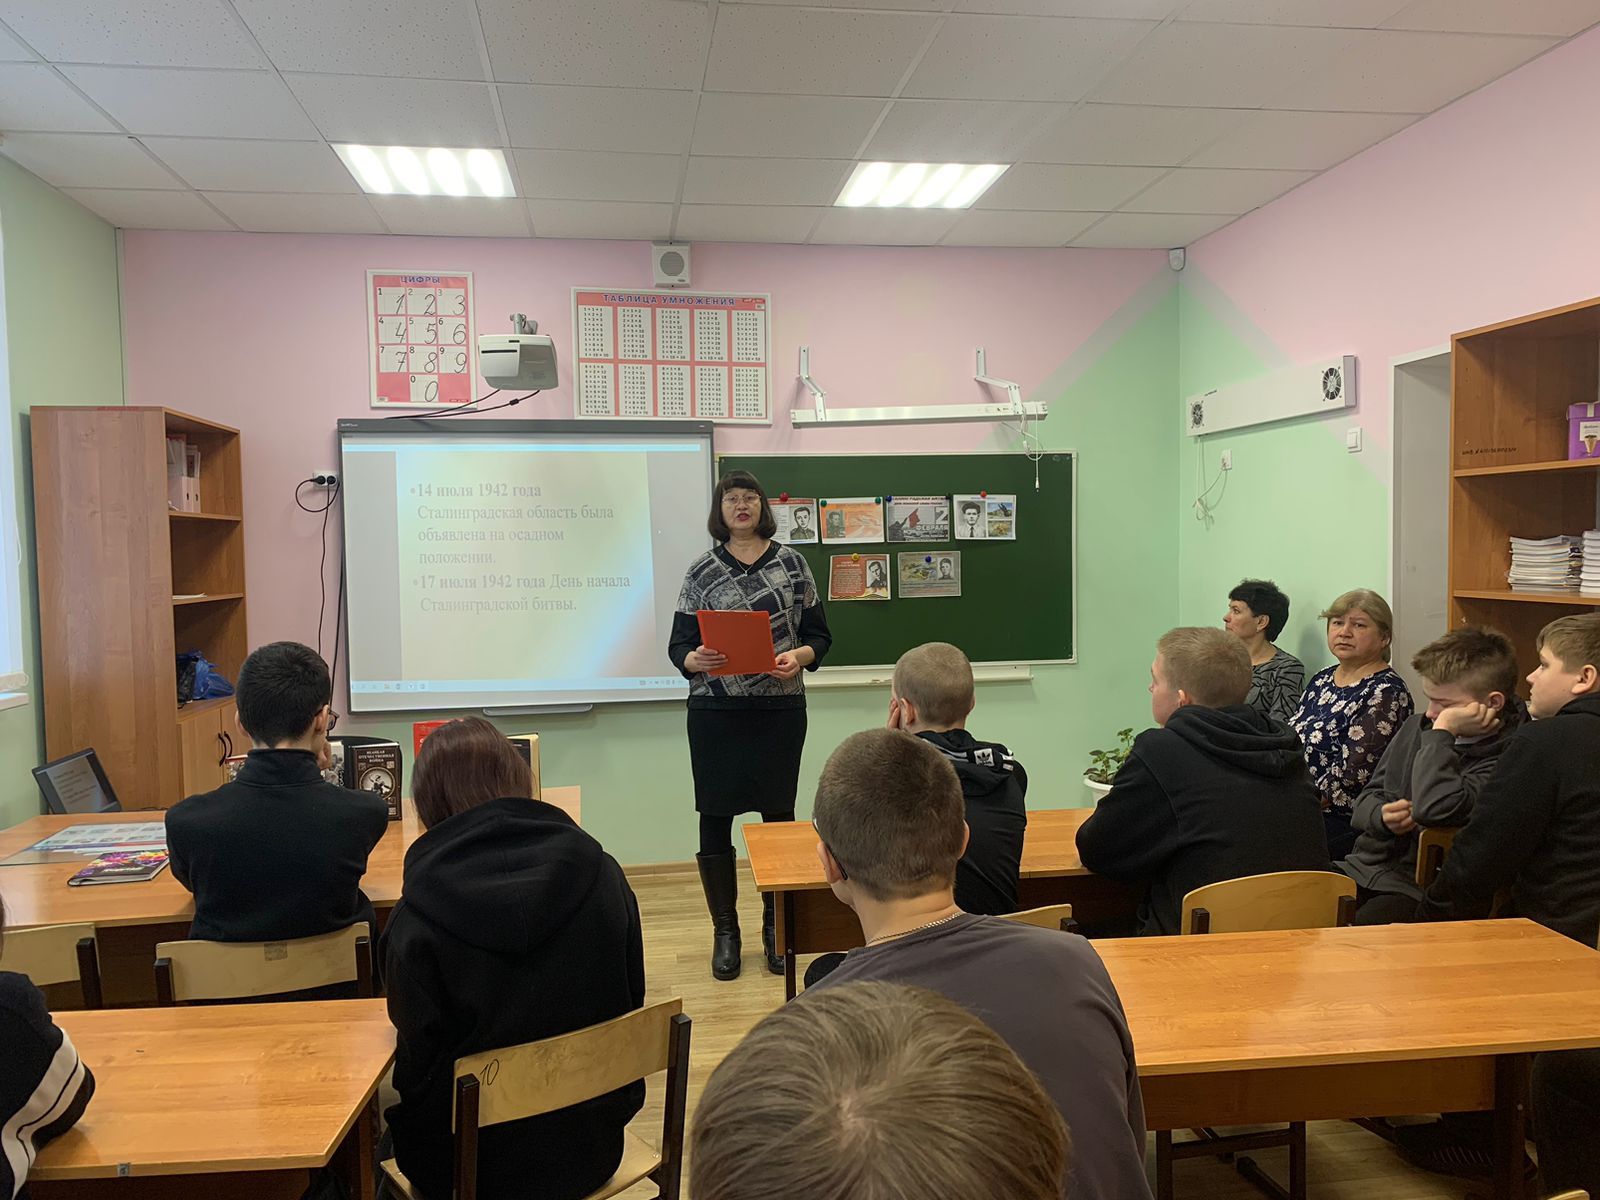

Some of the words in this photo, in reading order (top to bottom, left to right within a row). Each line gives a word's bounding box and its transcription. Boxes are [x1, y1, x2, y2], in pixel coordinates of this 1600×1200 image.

[396, 294, 405, 313] 1
[424, 294, 436, 315] 2
[453, 295, 465, 315] 3
[604, 294, 657, 303] ТАБЛИЦА
[662, 296, 735, 305] УМНОЖЕНИЯ
[395, 322, 406, 343] 4
[425, 324, 436, 344] 5
[453, 324, 466, 344] 6
[396, 352, 406, 371] 7
[424, 352, 437, 373] 8
[455, 352, 467, 373] 9
[425, 381, 438, 402] 0
[417, 484, 432, 497] 14
[437, 486, 473, 498] июля
[478, 484, 508, 497] 1942
[512, 486, 541, 498] года
[418, 505, 523, 522] Сталинградская
[527, 506, 577, 519] область
[580, 506, 614, 519] была
[418, 528, 485, 542] объявлена
[490, 530, 506, 541] на
[509, 531, 564, 543] осадном
[419, 552, 496, 566] положении.
[420, 576, 434, 589] 17
[440, 578, 477, 590] июля
[482, 575, 512, 589] 1942
[516, 577, 546, 589] года
[550, 575, 582, 590] День
[587, 576, 630, 588] начала
[421, 597, 528, 615] Сталинградской
[532, 598, 576, 612] битвы.
[480, 1058, 500, 1086] 10
